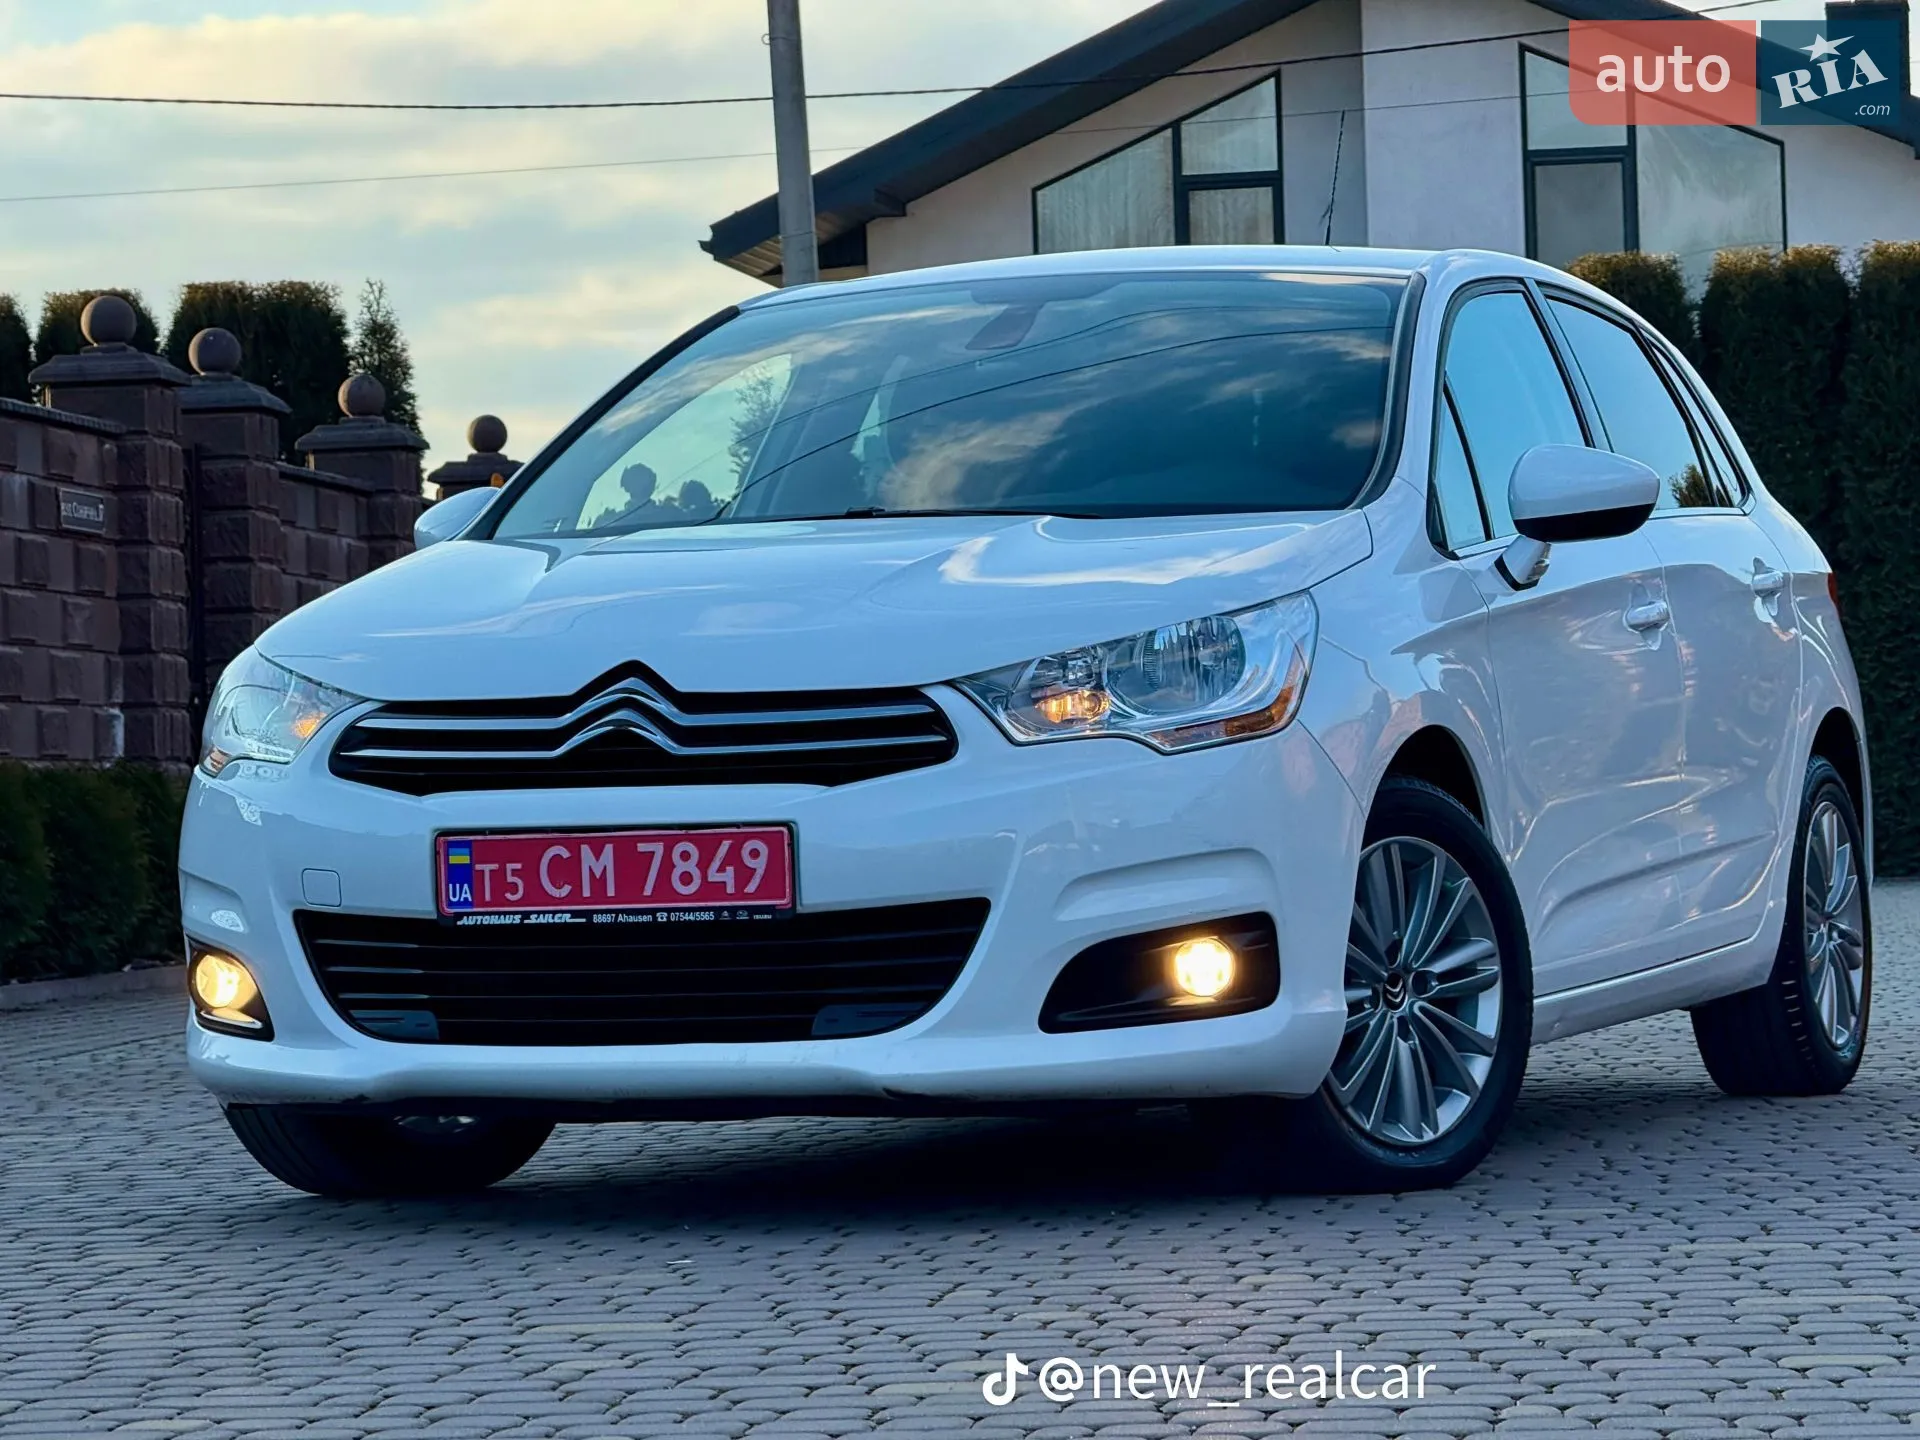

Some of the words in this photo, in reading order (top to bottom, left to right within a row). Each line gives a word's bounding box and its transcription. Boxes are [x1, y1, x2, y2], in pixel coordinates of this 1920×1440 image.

[475, 863, 524, 902] T5
[539, 843, 615, 899] CM
[637, 838, 769, 897] 7849
[448, 884, 472, 903] UA
[457, 914, 522, 925] AUTOHAUS
[524, 913, 586, 923] SAILER
[592, 913, 616, 923] 88697
[617, 912, 652, 922] Ahausen
[670, 911, 714, 922] 07544/5565
